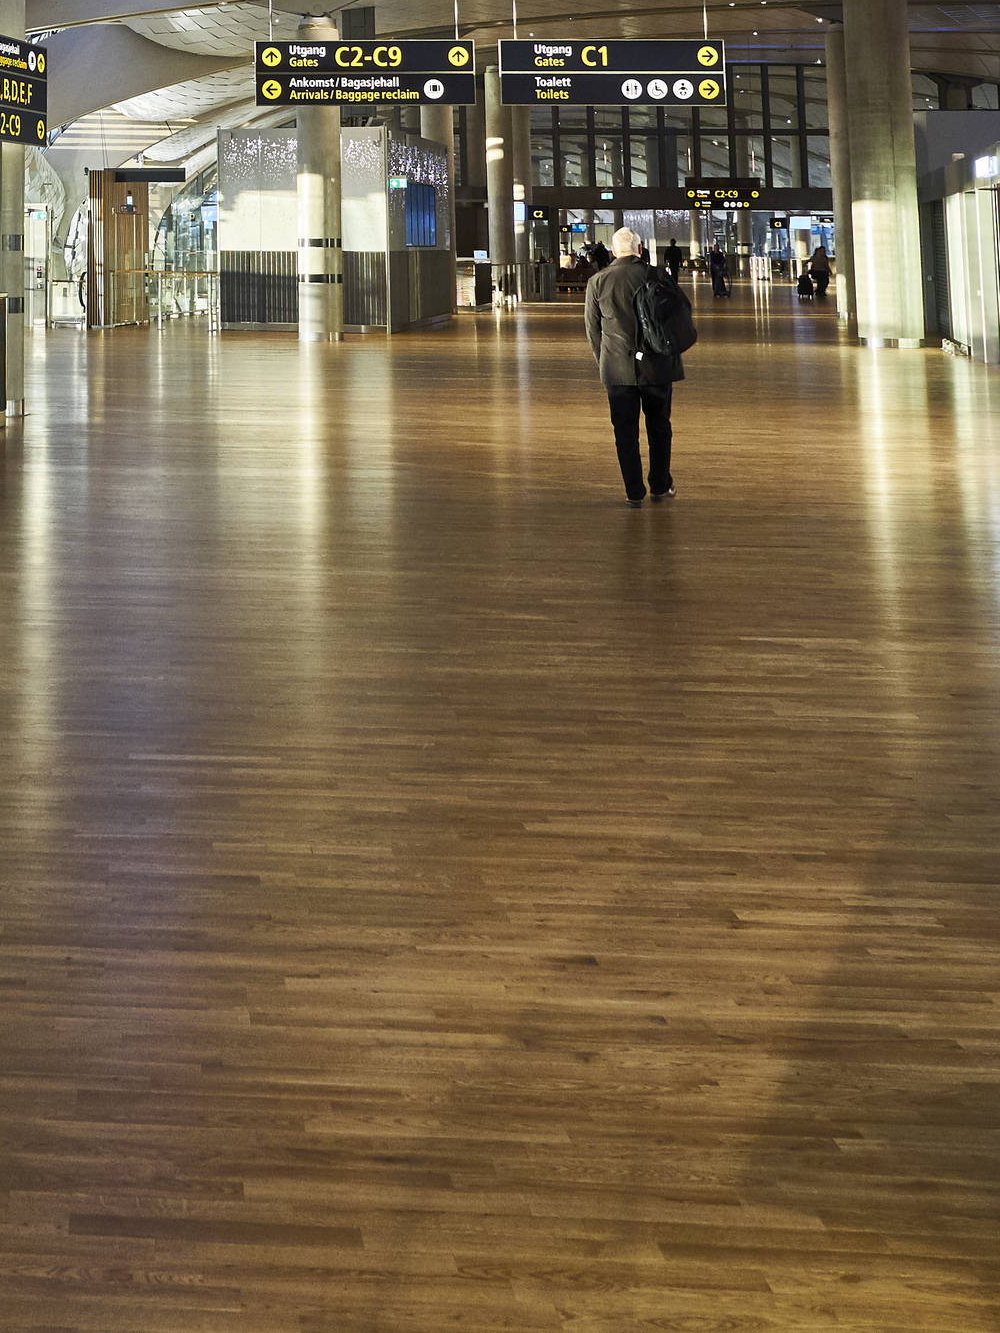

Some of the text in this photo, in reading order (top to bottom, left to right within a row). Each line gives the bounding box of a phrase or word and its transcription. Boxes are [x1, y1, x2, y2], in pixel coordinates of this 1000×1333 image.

[289, 45, 326, 57] Utgang
[534, 44, 572, 56] Utgang
[334, 46, 402, 67] C2-C9
[534, 57, 565, 66] Gates
[581, 46, 608, 66] C1
[289, 57, 319, 67] Gates
[289, 77, 335, 87] Ankomst
[341, 77, 399, 90] Bagasjehall
[534, 77, 571, 87] Toalett
[289, 89, 330, 100] Arrivals
[336, 90, 380, 102] Baggage
[382, 89, 420, 100] reclaim
[535, 89, 569, 100] Toilets
[714, 190, 739, 198] C2-C9
[533, 210, 543, 218] C2
